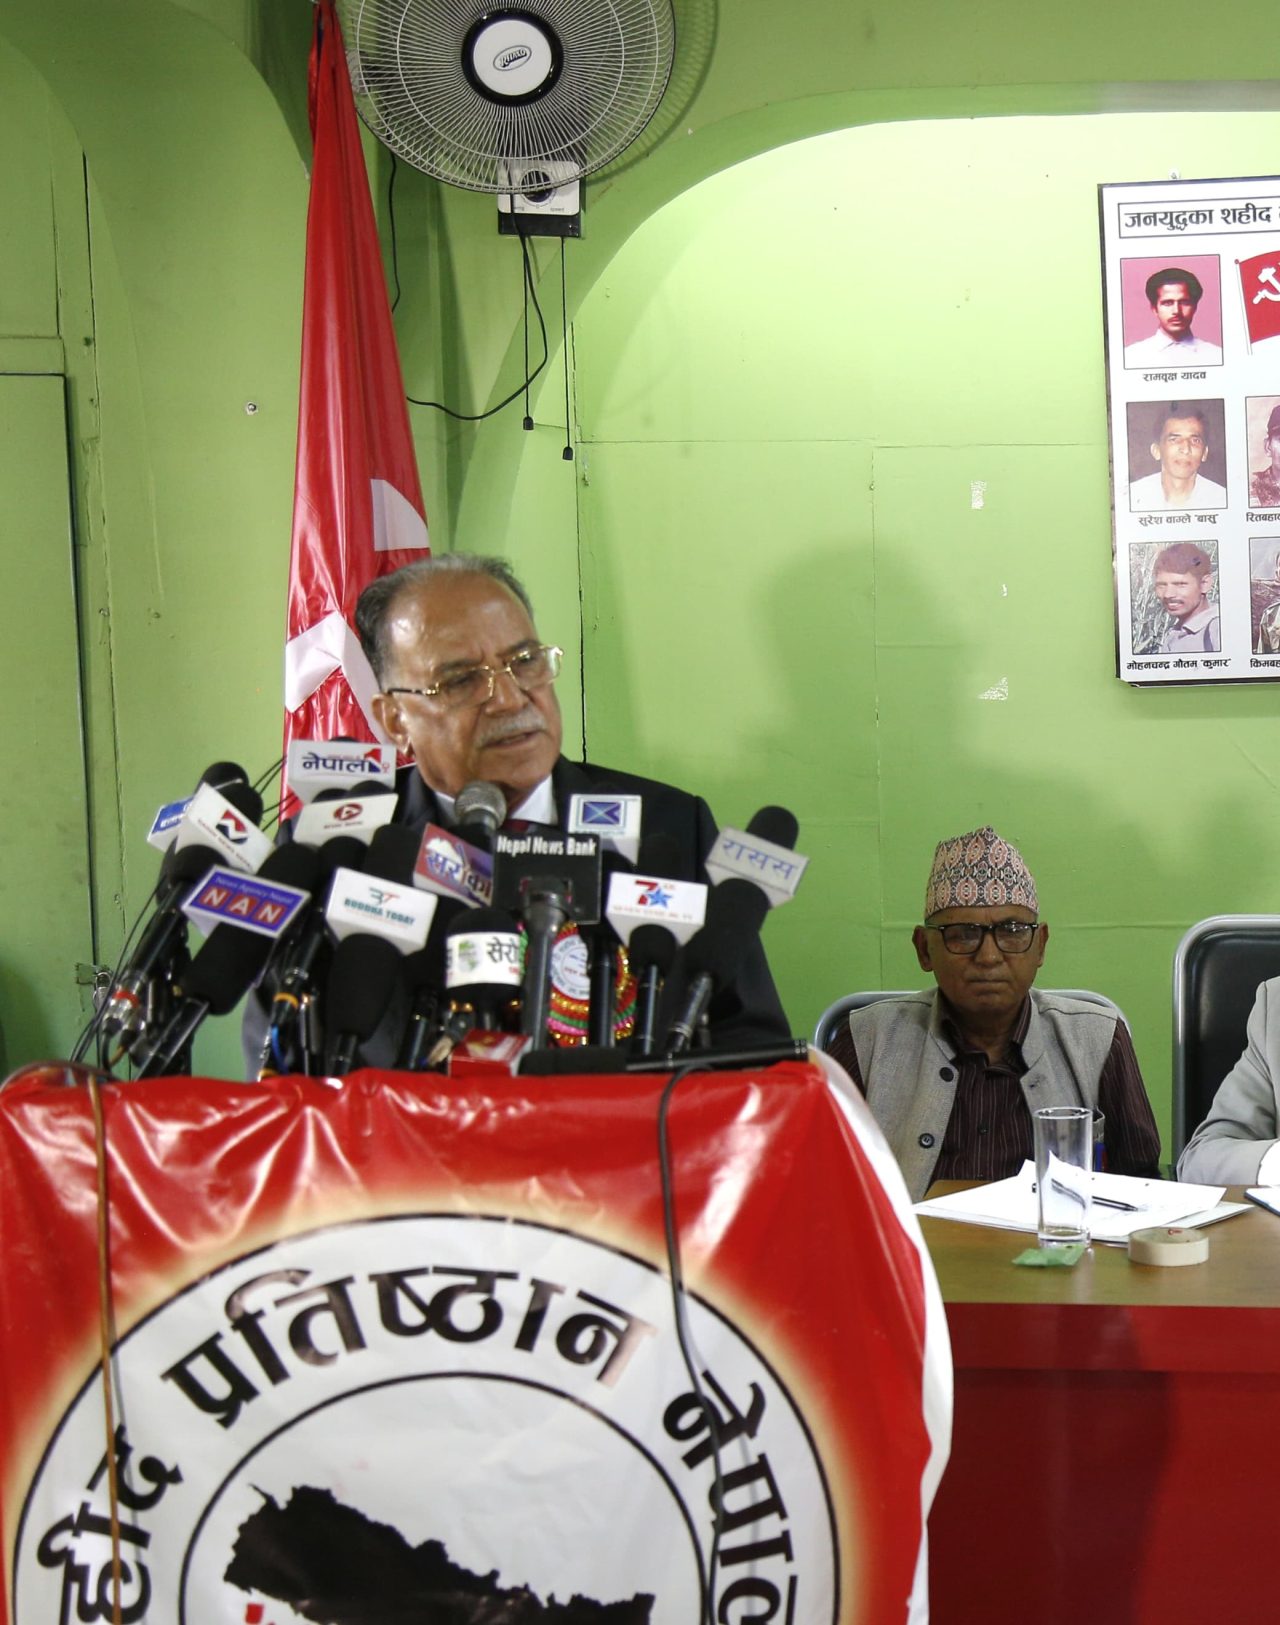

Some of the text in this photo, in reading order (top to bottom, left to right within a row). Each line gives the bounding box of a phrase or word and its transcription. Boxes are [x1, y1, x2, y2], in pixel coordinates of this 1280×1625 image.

[1124, 208, 1214, 231] जनयुद्धका
[1220, 203, 1272, 225] शहीद
[1181, 371, 1207, 380] यादव
[1138, 514, 1163, 526] सुरेश
[497, 835, 597, 858] Nepal News Bank
[723, 840, 799, 880] रासस
[203, 887, 282, 924] NAN
[344, 898, 383, 916] BUDDHA
[385, 910, 416, 926] TODAY
[37, 1423, 184, 1625] हीद
[159, 1264, 660, 1430] प्रतिष्ठान
